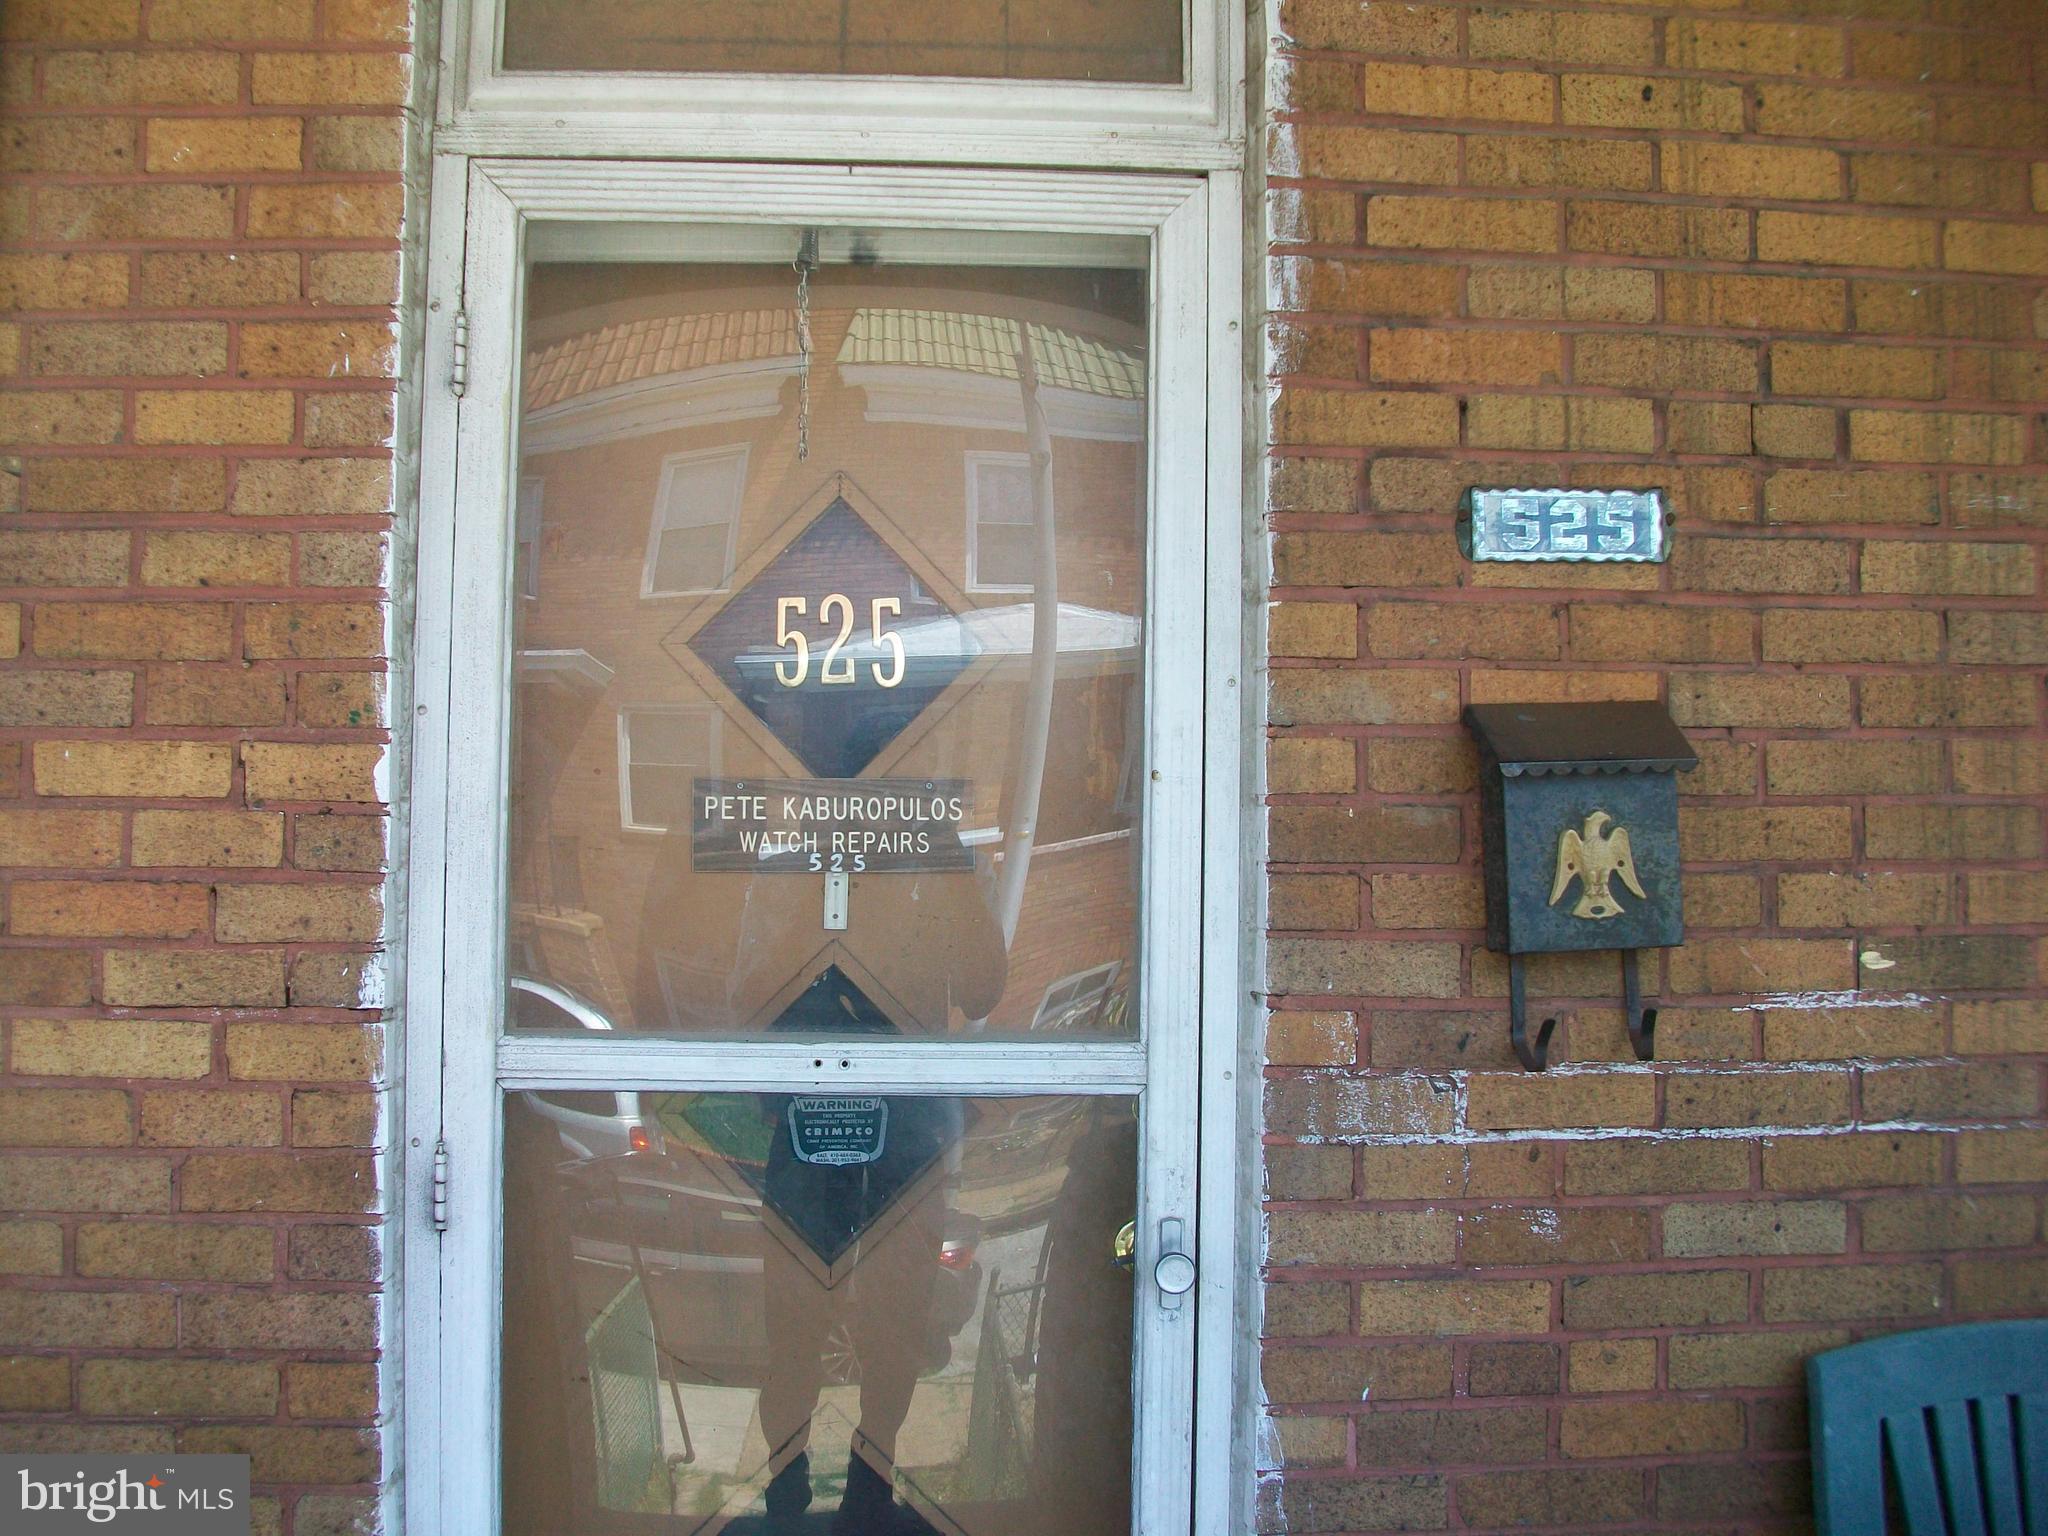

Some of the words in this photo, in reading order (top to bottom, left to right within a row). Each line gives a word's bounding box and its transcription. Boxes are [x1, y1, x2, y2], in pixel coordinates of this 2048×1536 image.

[1501, 498, 1635, 551] 525
[774, 593, 906, 688] 525
[704, 796, 767, 820] PETE
[783, 796, 963, 821] KABUROPULOS
[739, 831, 818, 853] WATCH
[832, 831, 930, 853] REPAIRS
[802, 1100, 873, 1110] WARNING
[804, 1126, 873, 1136] CRIMPCO
